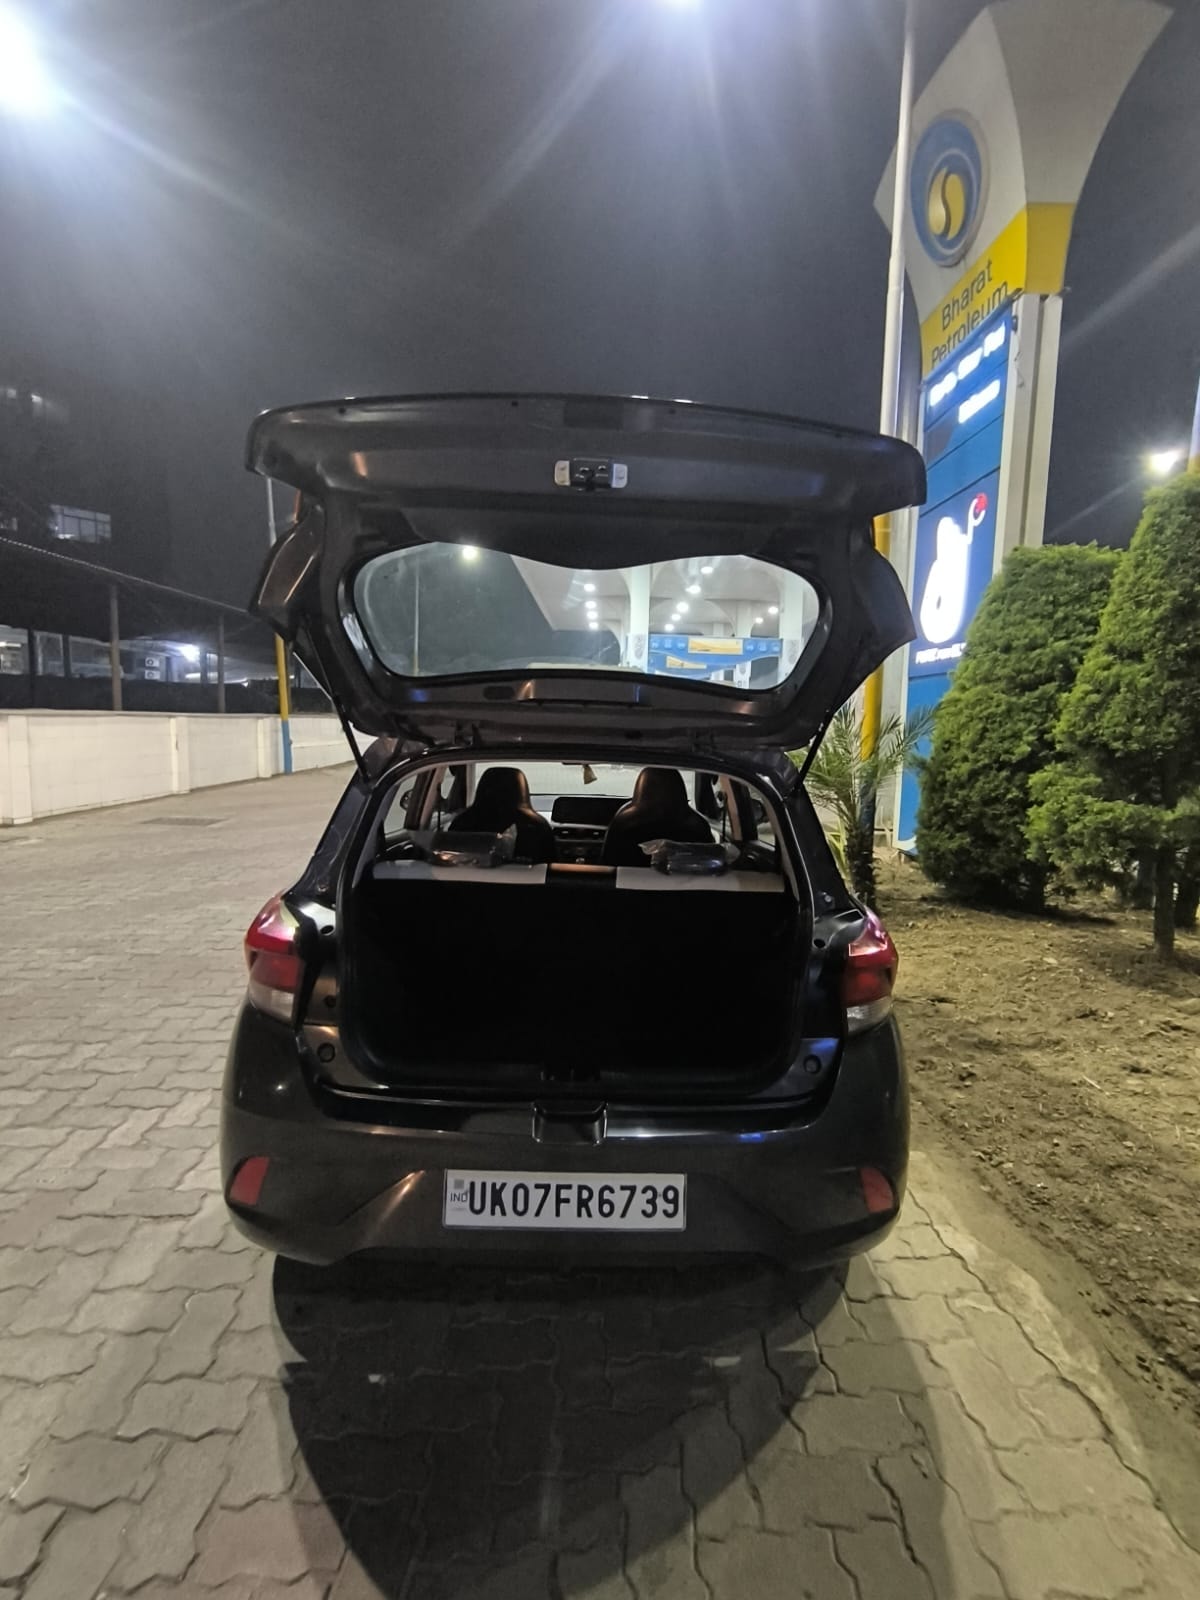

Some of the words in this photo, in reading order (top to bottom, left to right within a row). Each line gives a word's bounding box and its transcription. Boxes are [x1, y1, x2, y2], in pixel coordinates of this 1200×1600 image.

[942, 260, 993, 331] Bharat
[931, 282, 1008, 365] Petroleum
[450, 1192, 468, 1203] IND
[469, 1181, 680, 1219] UK07FR6739
